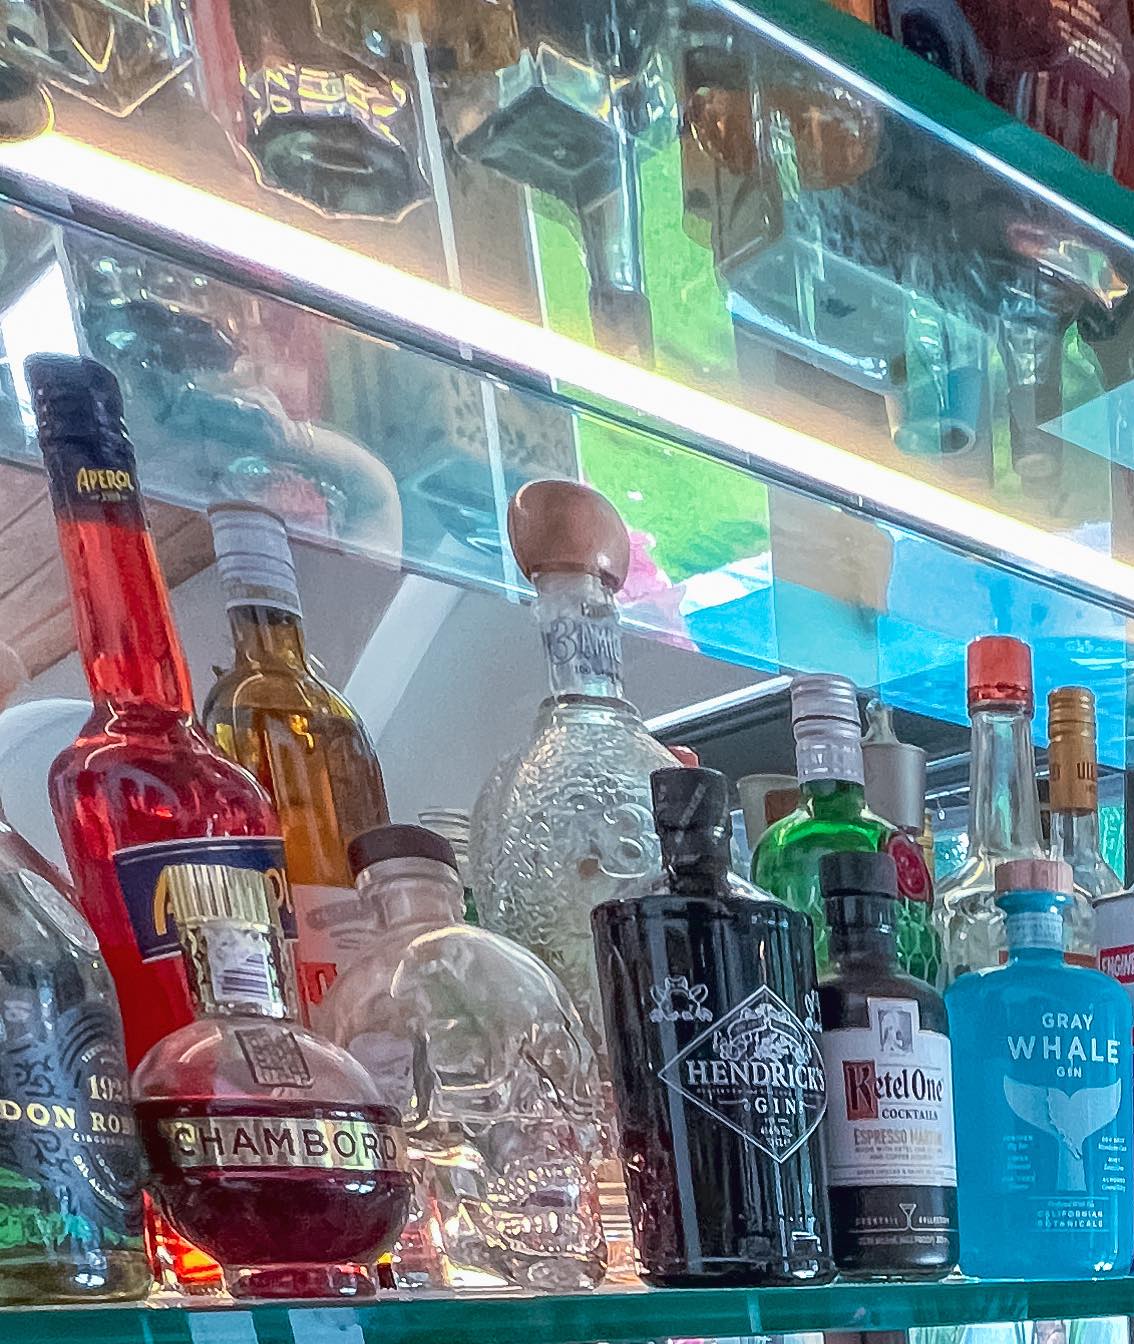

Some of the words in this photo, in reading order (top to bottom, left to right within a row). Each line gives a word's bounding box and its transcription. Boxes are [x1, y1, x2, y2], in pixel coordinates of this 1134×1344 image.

[76, 466, 135, 493] APEROL
[1042, 1012, 1093, 1031] GRAY
[1007, 1036, 1121, 1064] WHALE
[686, 1059, 825, 1092] HENDRICK'S
[1056, 1066, 1082, 1078] GIN
[847, 1063, 909, 1115] Ketel
[911, 1068, 943, 1102] One
[755, 1097, 797, 1115] GIN
[173, 1126, 398, 1162] CHAMBORD
[854, 1127, 907, 1146] ESPRESSO
